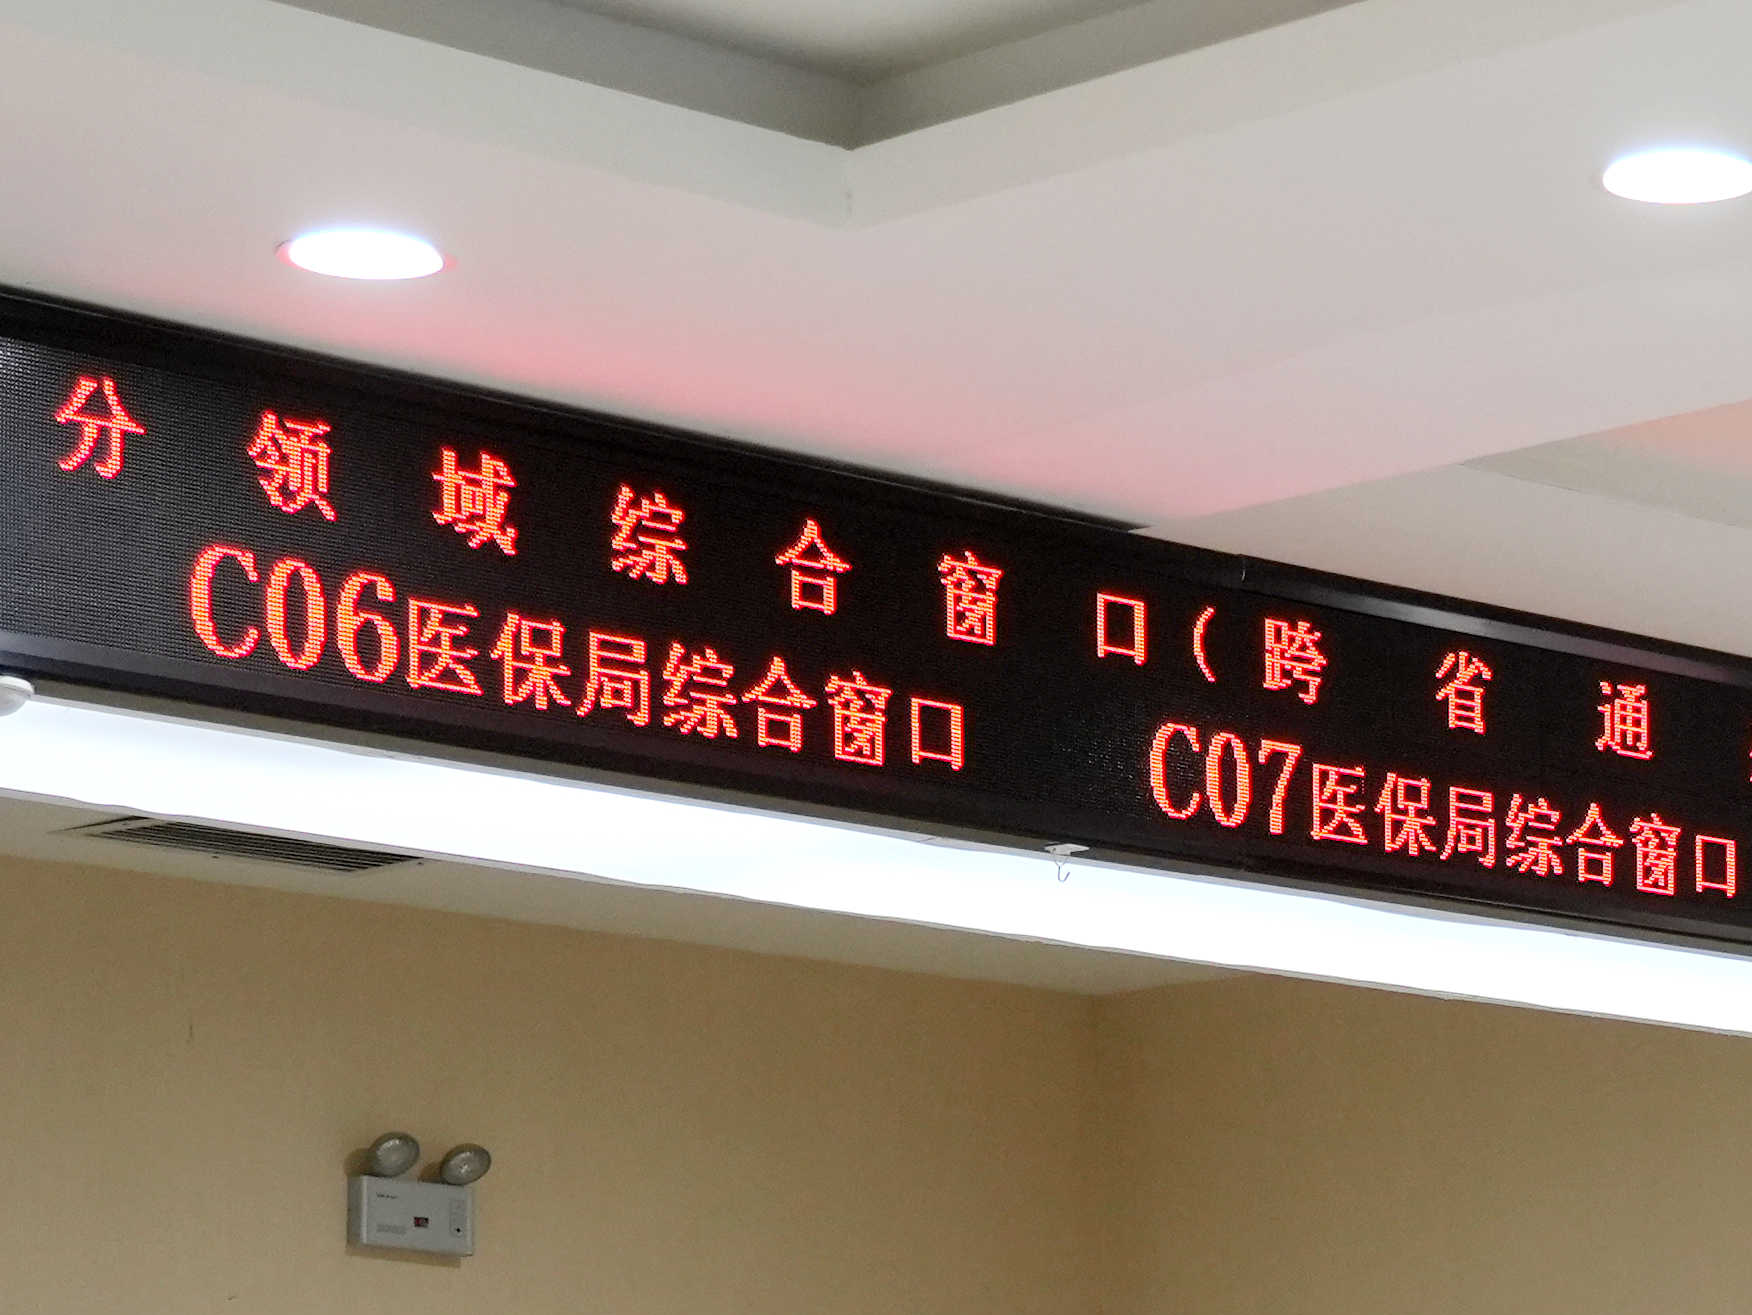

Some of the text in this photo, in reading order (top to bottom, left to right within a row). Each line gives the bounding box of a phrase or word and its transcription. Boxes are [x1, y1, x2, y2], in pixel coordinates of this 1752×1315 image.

[190, 543, 965, 769] C06医保局综合窗口
[1149, 722, 1738, 896] C07医保局综合窗口
